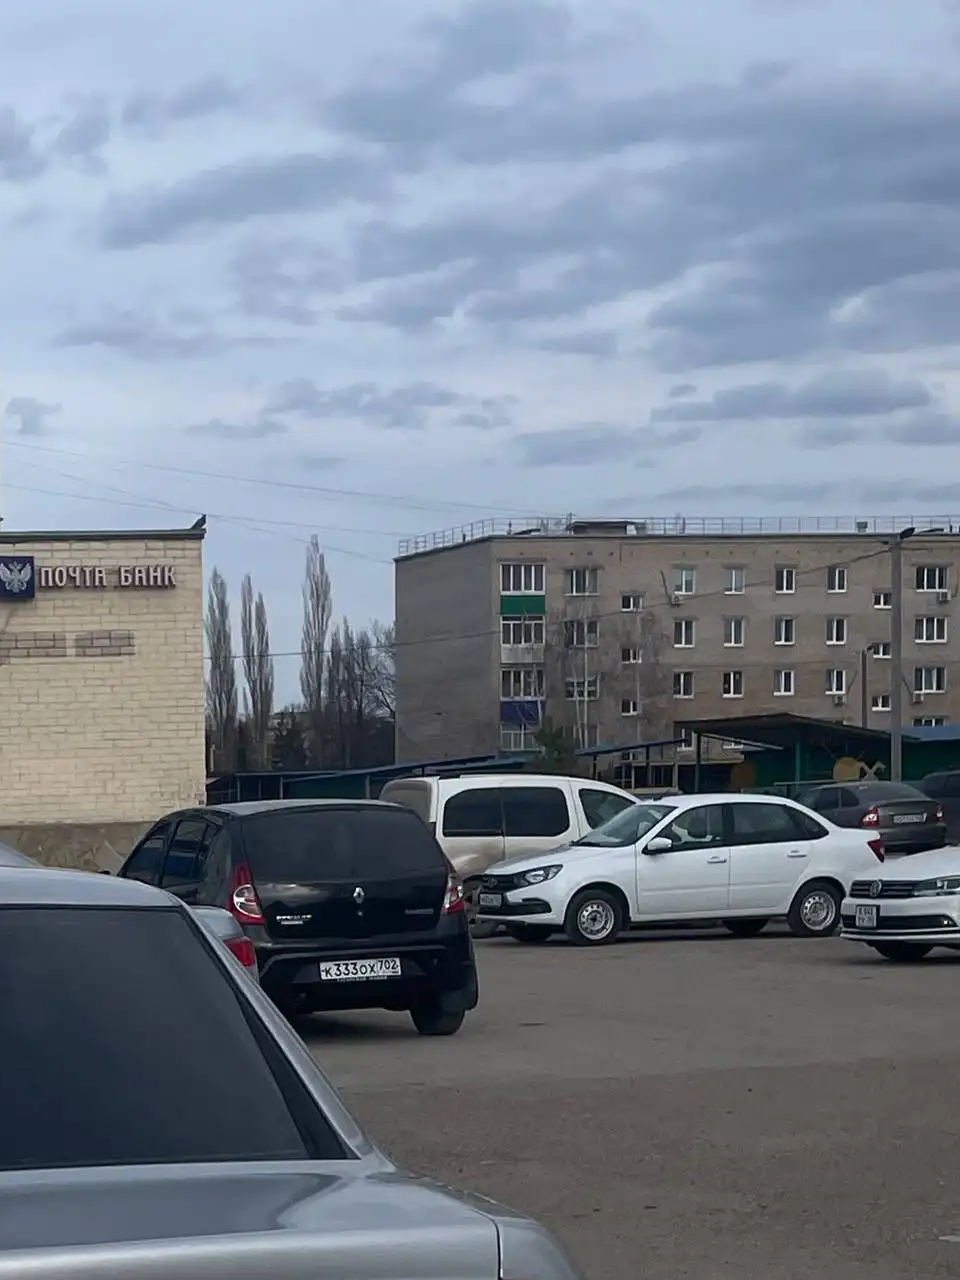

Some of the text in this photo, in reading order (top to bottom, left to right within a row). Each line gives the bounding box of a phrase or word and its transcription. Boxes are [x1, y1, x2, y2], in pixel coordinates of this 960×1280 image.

[40, 566, 176, 588] ПОЧТА БАНК
[324, 959, 397, 978] К333ОХ 702
